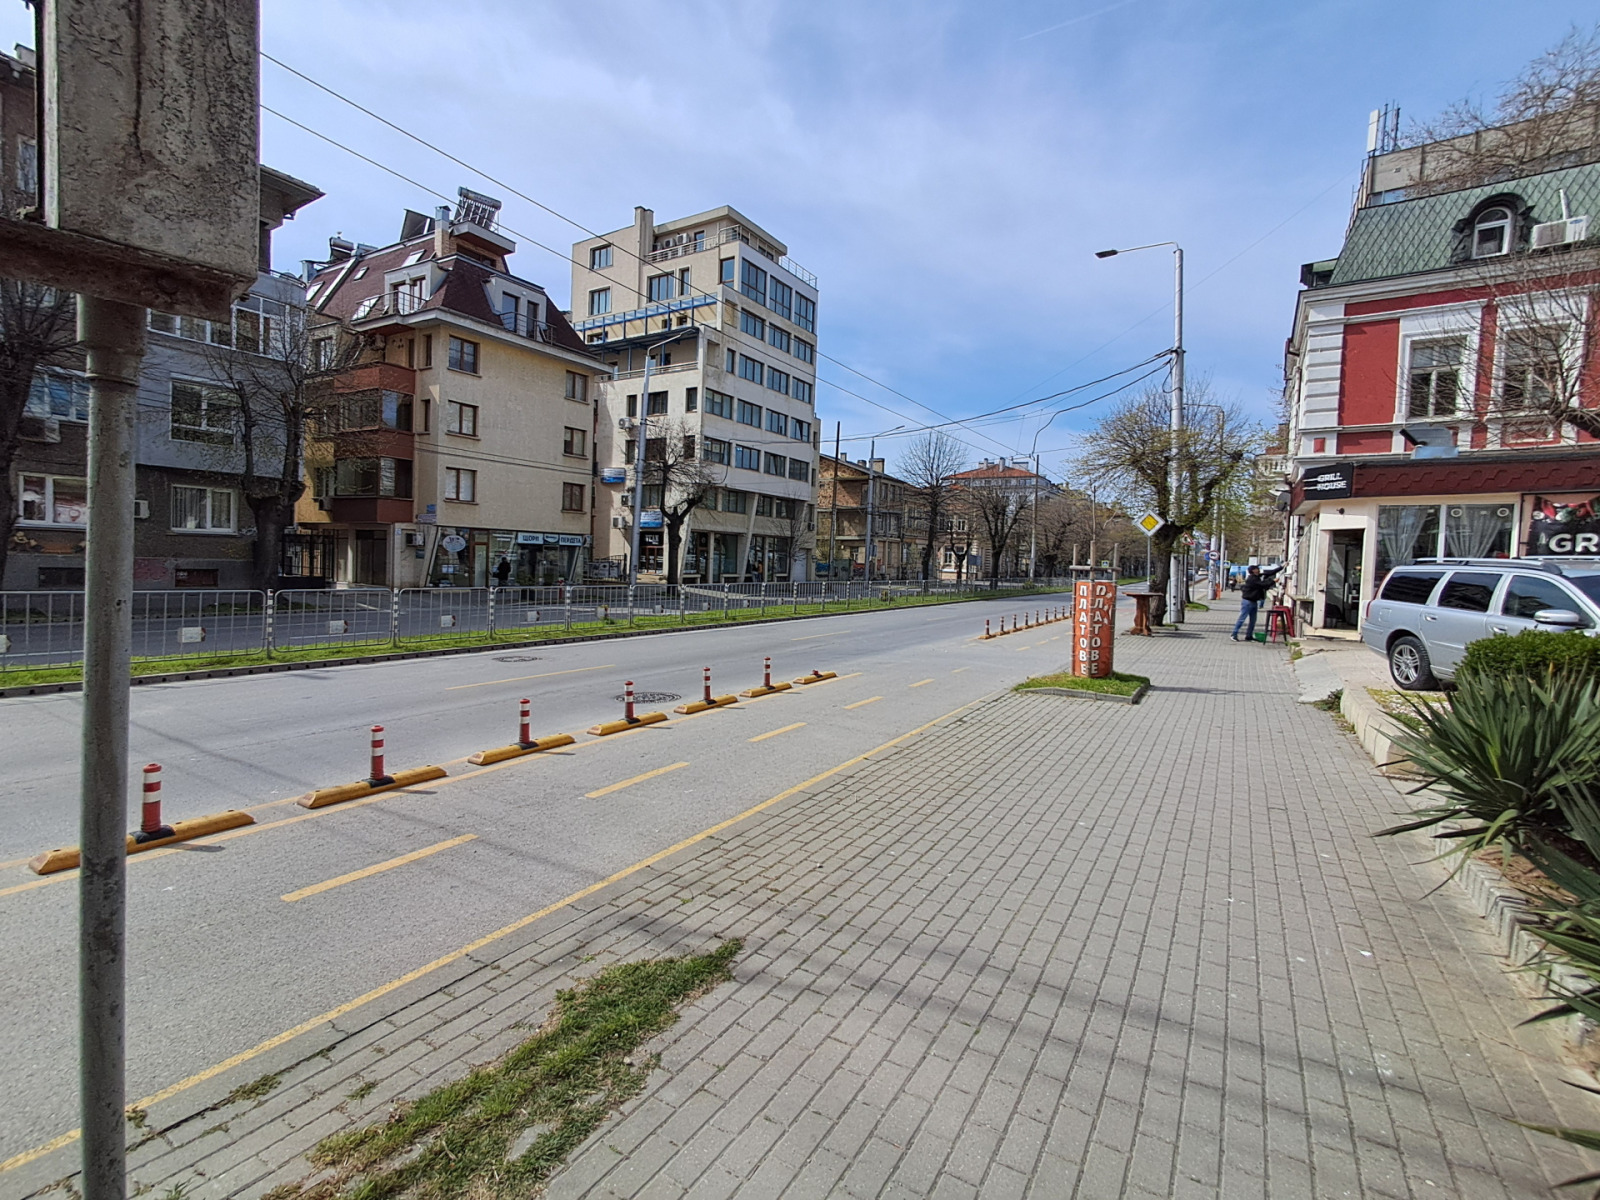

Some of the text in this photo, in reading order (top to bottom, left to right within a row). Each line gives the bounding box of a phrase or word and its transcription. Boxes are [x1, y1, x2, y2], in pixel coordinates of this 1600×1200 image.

[1317, 472, 1343, 482] GRILL
[1316, 480, 1347, 491] HOUSE
[560, 536, 582, 544] ПЕРДЕТА
[1078, 585, 1088, 676] ПЛАТОВЕ
[1090, 585, 1107, 675] ПЛАТОВЕ
